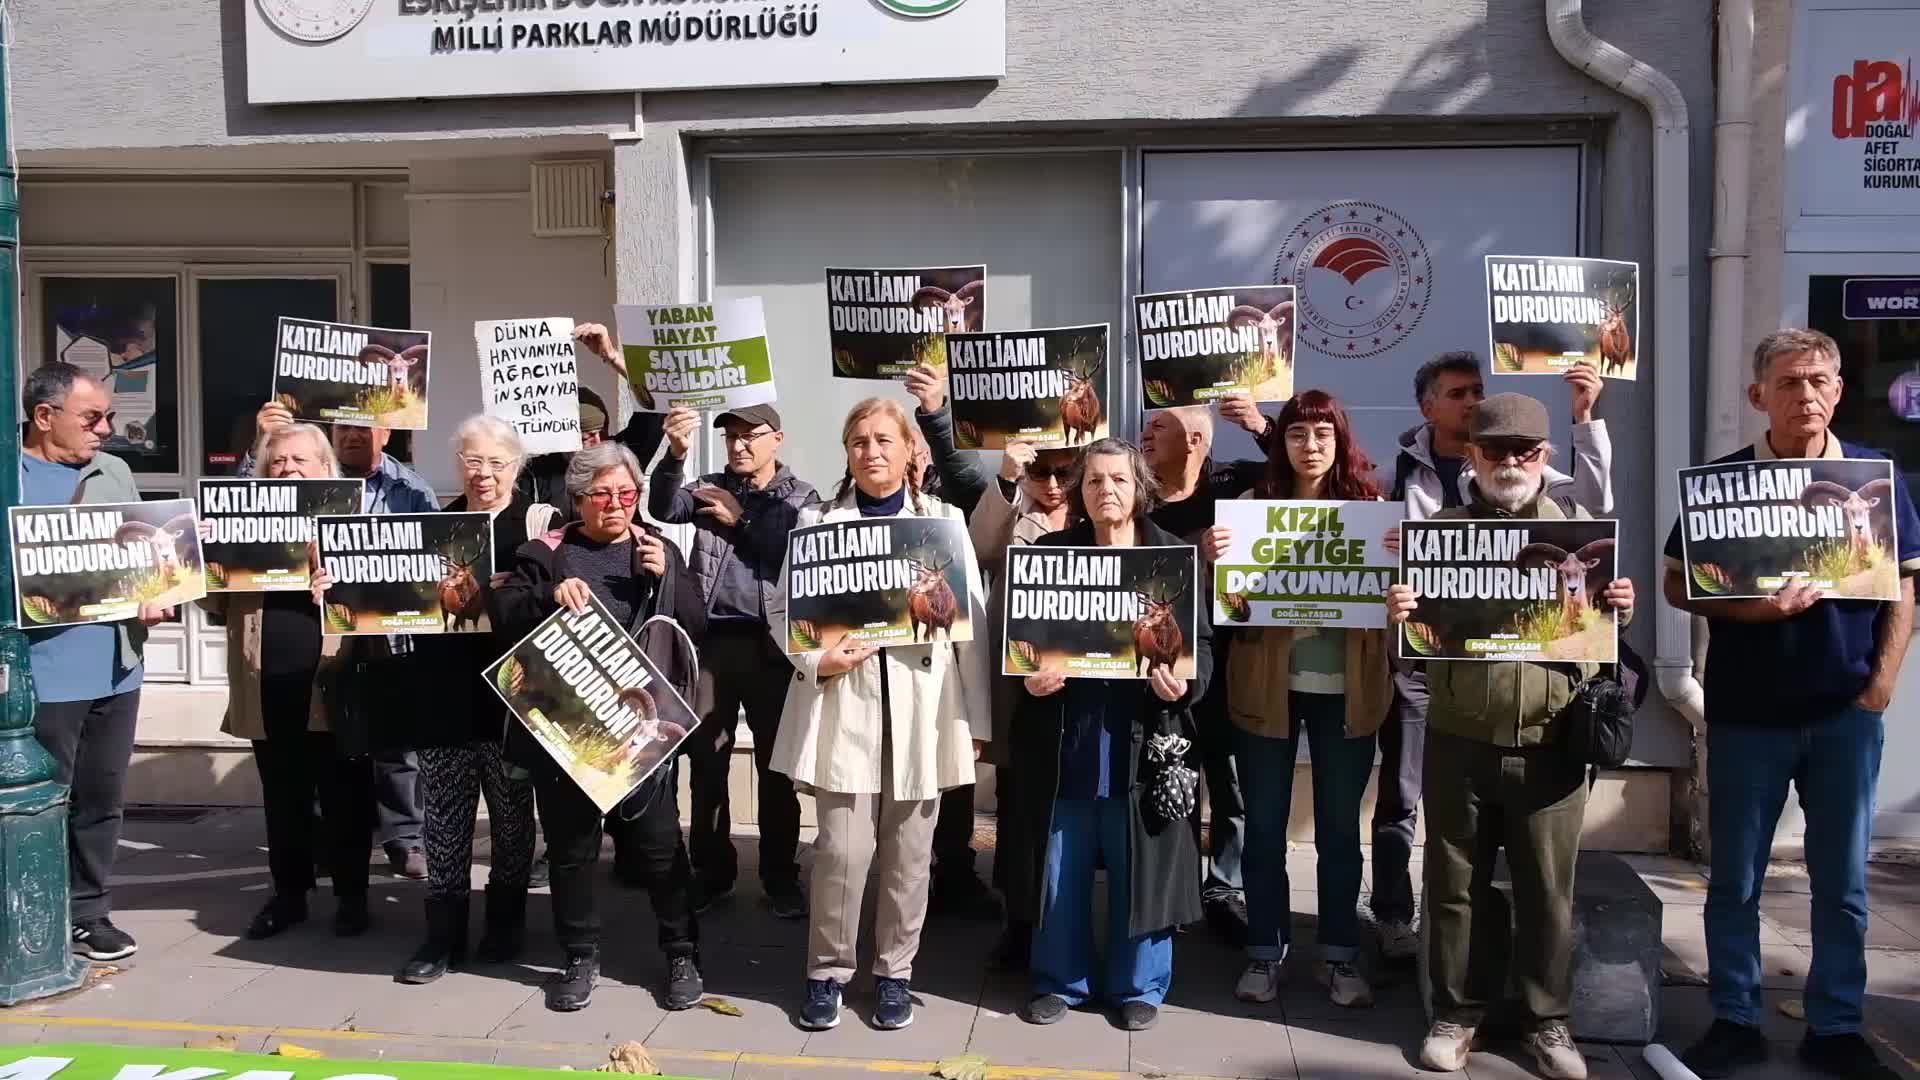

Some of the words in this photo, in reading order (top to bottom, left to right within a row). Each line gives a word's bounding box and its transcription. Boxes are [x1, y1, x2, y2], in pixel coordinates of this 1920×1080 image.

[432, 17, 503, 51] MİLLİ
[511, 20, 632, 48] PARKLAR
[639, 3, 818, 44] MÜDÜRLÜĞÜ
[1866, 121, 1911, 138] DOĞAL
[1864, 142, 1899, 155] AFET
[1864, 156, 1920, 172] SİGORTA
[1491, 260, 1585, 293] KATLİAMI
[646, 305, 714, 325] YABAN
[832, 305, 944, 333] DURDURUN!
[495, 321, 552, 342] DÜNYA
[653, 325, 718, 345] HAYAT
[1142, 325, 1260, 361] DURDURUN!
[490, 343, 574, 366] HAYVANIYLA
[649, 346, 733, 370] SATILIK
[950, 334, 1046, 368] KATLİAMI
[279, 352, 388, 386] DURDURUN!
[493, 361, 575, 384] AĞACIYLA
[495, 381, 577, 404] İNSANIYLA
[521, 401, 552, 416] BİR
[512, 418, 579, 434] TÜNDÜR
[203, 482, 298, 513] KATLİAMI
[1266, 506, 1344, 533] KIZIL
[1688, 505, 1845, 542] DURDURUN!
[322, 518, 424, 552] KATLİAMI
[792, 524, 892, 566] KATLİAMI
[1251, 533, 1366, 565] GEYİĞE
[19, 541, 153, 577] DURDURUN!
[1013, 550, 1121, 586] KATLİAMI
[1226, 570, 1391, 597] DOKUNMA!
[1407, 567, 1557, 600] DURDURUN!
[532, 622, 640, 741] DURDURUN!
